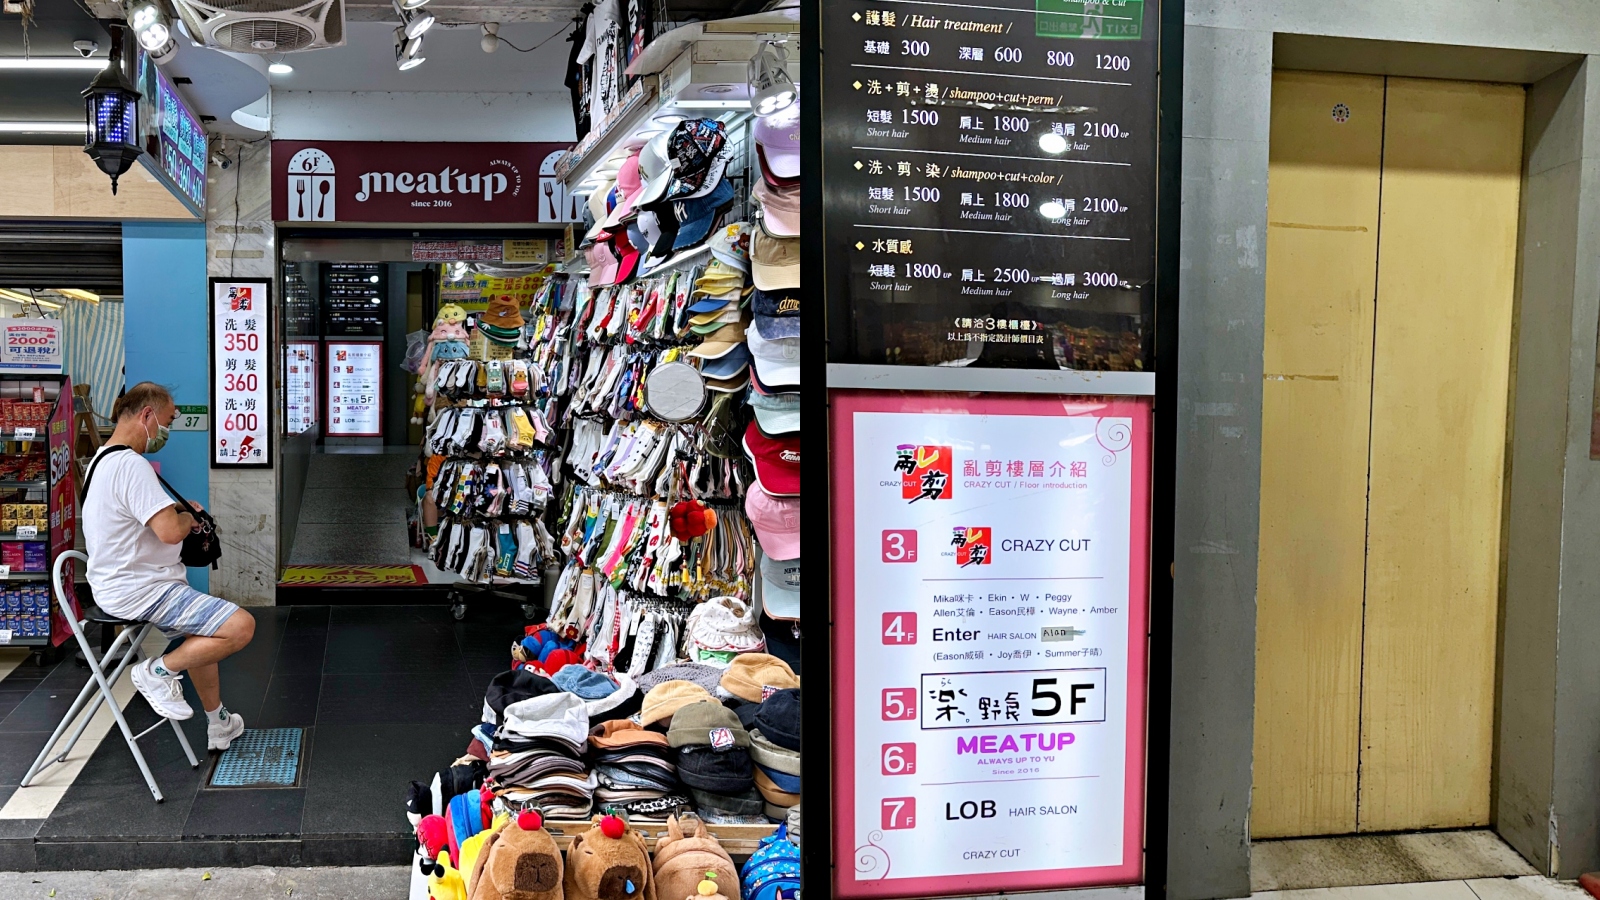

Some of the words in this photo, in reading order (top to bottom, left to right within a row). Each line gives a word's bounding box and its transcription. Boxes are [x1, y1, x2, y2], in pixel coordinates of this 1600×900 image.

[866, 10, 896, 27] 護髮
[911, 15, 940, 29] Hair
[944, 17, 1003, 34] treatment
[864, 40, 890, 55] 基礎
[901, 40, 930, 57] 300
[958, 46, 984, 61] 深層
[994, 47, 1022, 63] 600
[1047, 50, 1074, 67] 800
[1095, 54, 1130, 71] 1200
[867, 110, 892, 124] 短髮
[902, 109, 939, 126] 1500
[959, 116, 984, 130] 肩上
[994, 116, 1029, 132] 1800
[1051, 122, 1076, 136] 過肩
[1083, 121, 1119, 138] 2100
[867, 128, 889, 138] Short
[891, 129, 909, 139] hair
[959, 134, 991, 145] Medium
[994, 136, 1011, 146] hair
[1073, 142, 1090, 151] hair
[302, 156, 320, 172] 6F
[490, 159, 511, 168] ALWAYS
[511, 166, 519, 174] UP
[516, 175, 521, 183] TO
[163, 141, 177, 181] 350
[179, 157, 191, 196] 360
[192, 174, 203, 209] 600
[355, 166, 508, 202] meatup
[433, 200, 452, 208] 2016
[868, 187, 894, 201] 短髮
[904, 187, 940, 203] 1500
[960, 193, 985, 207] 肩上
[994, 193, 1029, 208] 1800
[1083, 197, 1119, 213] 2100
[868, 205, 890, 215] Short
[893, 206, 911, 216] hair
[960, 211, 992, 222] Medium
[994, 213, 1012, 223] hair
[1052, 217, 1072, 226] Long
[1073, 216, 1090, 226] hair
[872, 239, 913, 255] 水質感
[869, 264, 896, 278] 短髮
[904, 263, 941, 280] 1800
[961, 269, 986, 283] 肩上
[993, 268, 1030, 284] 2500
[1051, 272, 1075, 287] 過肩
[1083, 272, 1118, 288] 3000
[870, 281, 891, 291] Short
[893, 282, 912, 292] hair
[961, 287, 993, 298] Medium
[995, 288, 1012, 298] hair
[1051, 290, 1071, 301] Long
[1073, 290, 1090, 301] hair
[225, 319, 257, 331] 洗髮
[9, 337, 48, 345] 2000
[224, 333, 258, 351] 350
[225, 358, 256, 371] 剪髮
[224, 374, 258, 392] 360
[185, 416, 199, 427] 37
[224, 413, 258, 431] 600
[51, 443, 70, 488] Sale
[963, 460, 1087, 478] 亂剪樓層介紹
[1020, 481, 1040, 489] Floor
[1043, 481, 1087, 489] introduction
[885, 532, 915, 560] 3F
[1001, 539, 1055, 552] CRAZY
[1059, 539, 1091, 552] CUT
[988, 593, 1007, 602] Ekin
[1020, 593, 1030, 601] W
[1045, 593, 1072, 603] Peggy
[1048, 607, 1078, 616] Wayne
[1090, 606, 1118, 615] Amber
[884, 615, 914, 642] 4F
[932, 627, 981, 642] Enter
[987, 632, 1008, 640] HAIR
[1009, 632, 1037, 640] SALON
[885, 692, 914, 719] 5F
[1031, 677, 1095, 717] 5F
[957, 732, 1076, 755] MEATUP
[883, 746, 913, 773] 6F
[977, 757, 1013, 765] ALWAYS
[883, 801, 913, 827] 7F
[945, 800, 997, 821] LOB
[1009, 806, 1036, 817] HAIR
[1039, 805, 1078, 816] SALON
[963, 851, 998, 860] CRAZY
[1000, 849, 1020, 859] CUT
